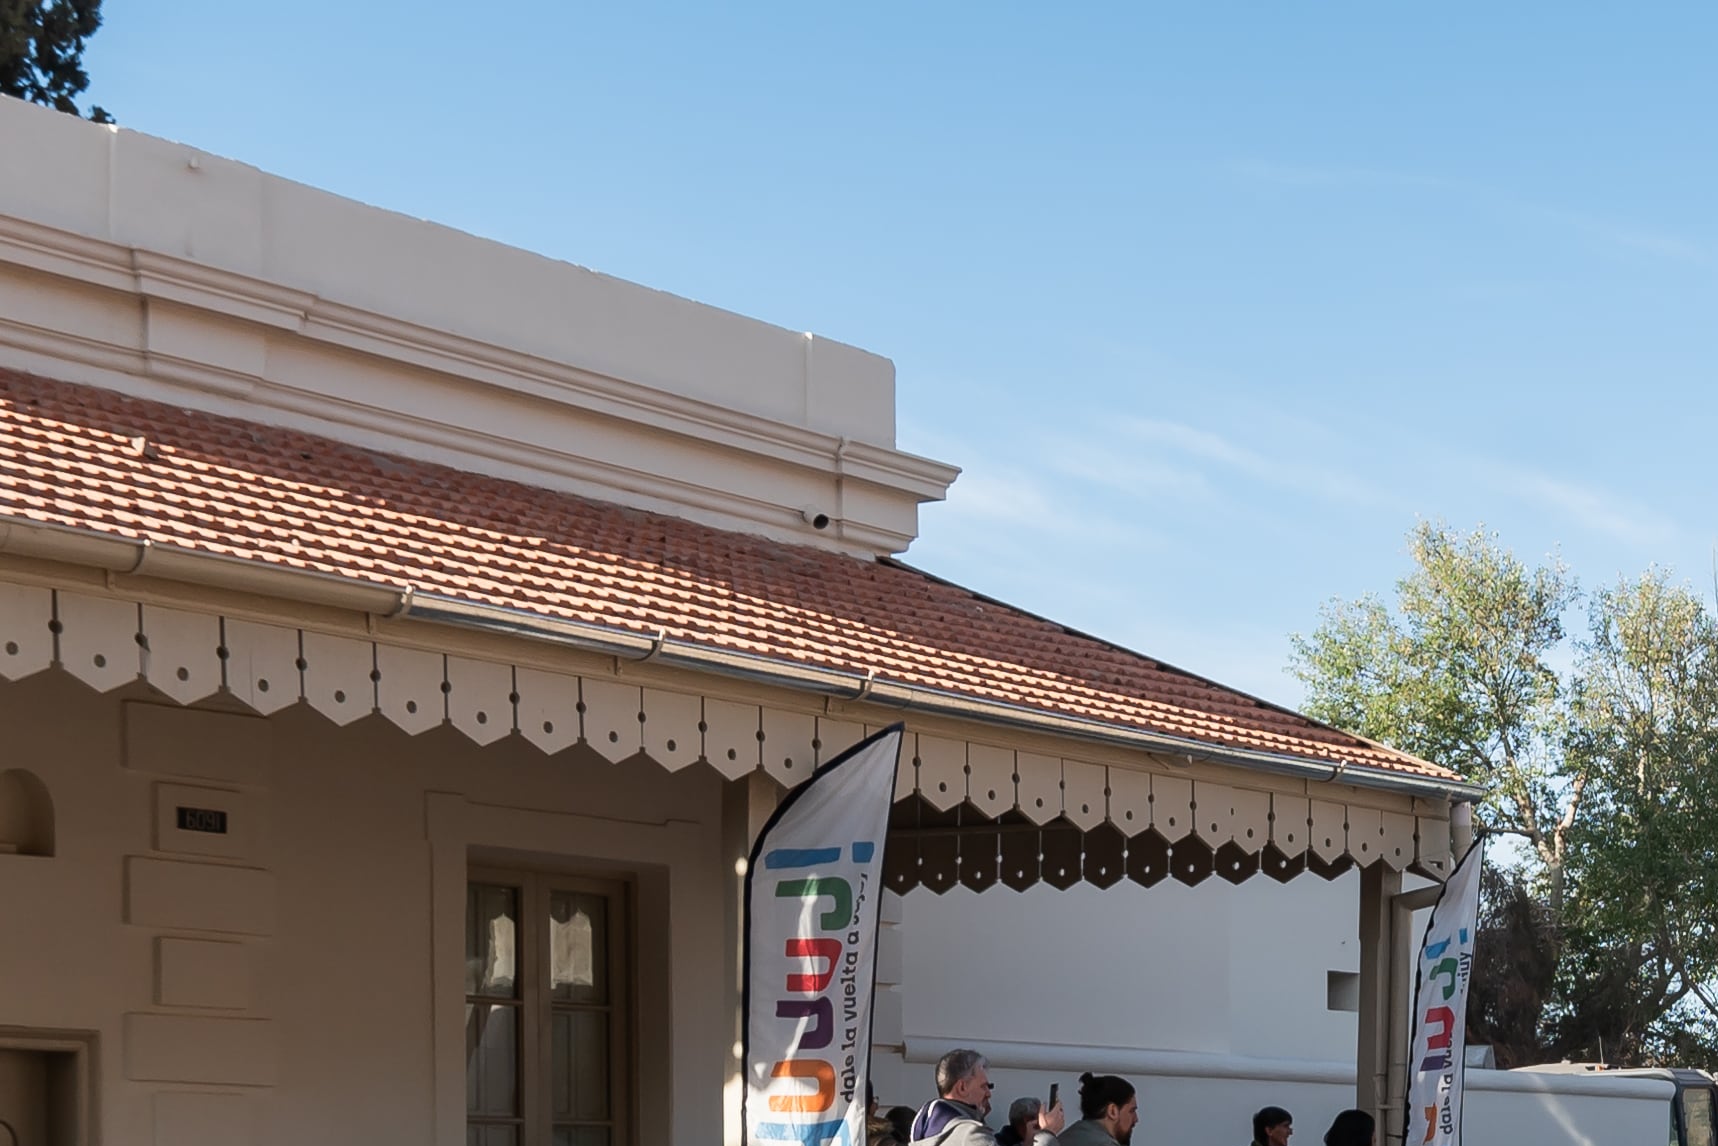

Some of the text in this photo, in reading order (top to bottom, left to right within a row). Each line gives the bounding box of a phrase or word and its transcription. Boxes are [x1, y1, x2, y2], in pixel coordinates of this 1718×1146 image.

[840, 931, 860, 1103] dale la vuelta a
